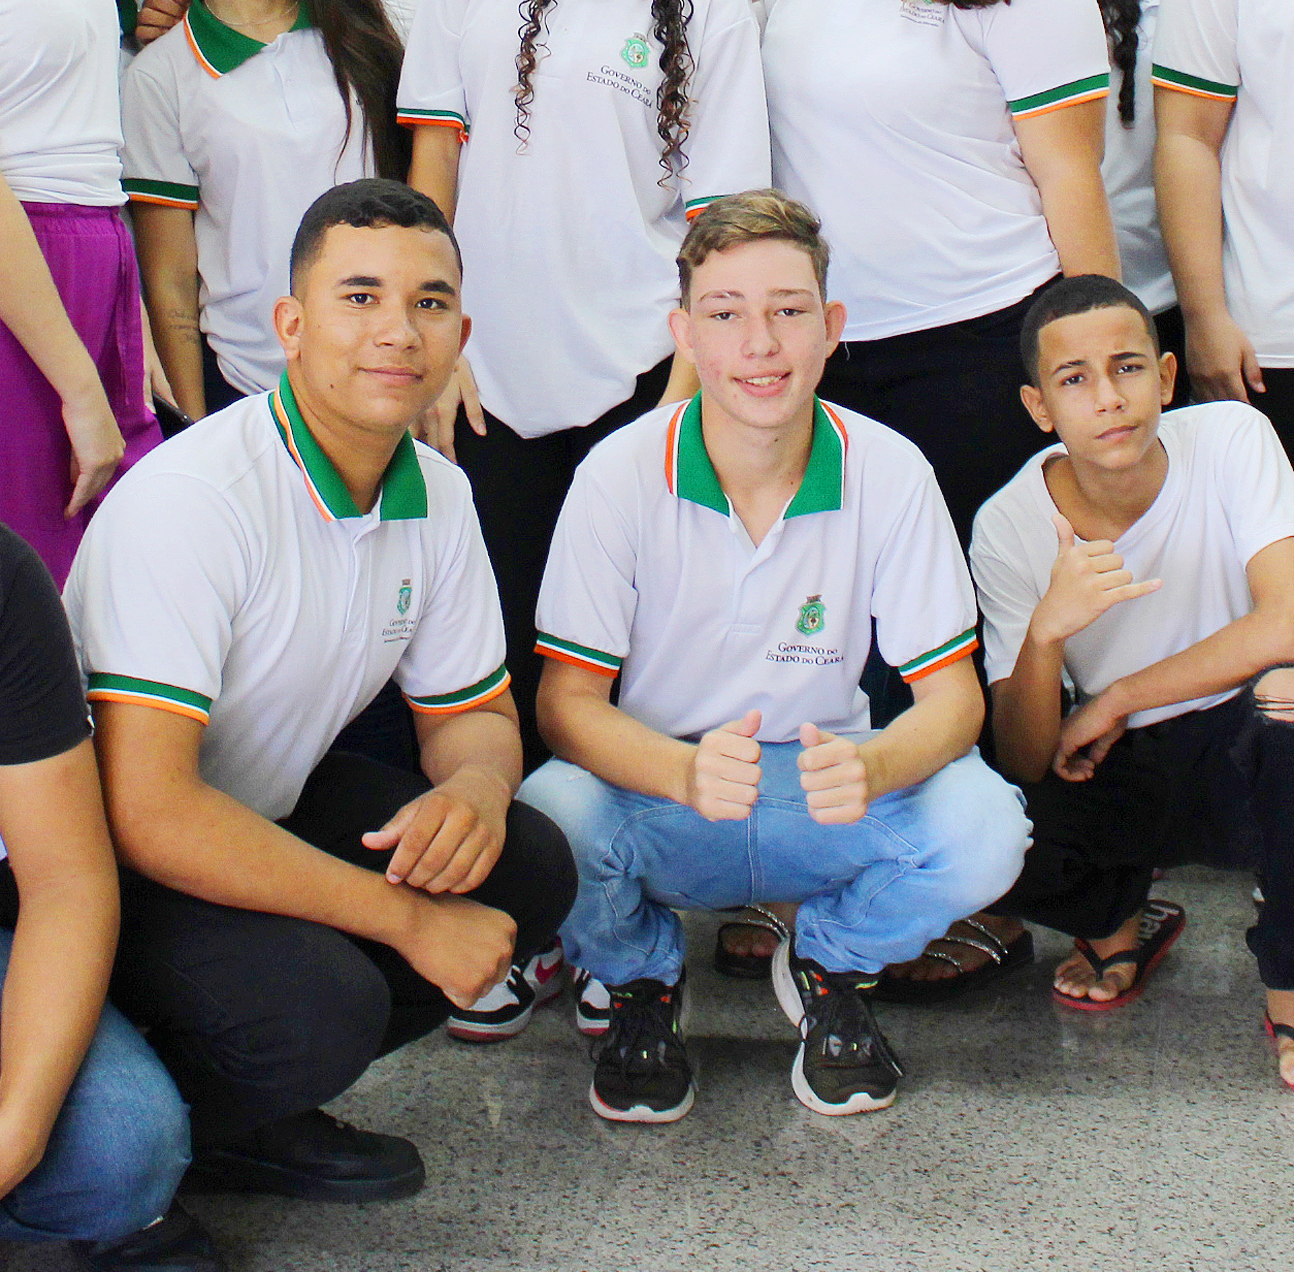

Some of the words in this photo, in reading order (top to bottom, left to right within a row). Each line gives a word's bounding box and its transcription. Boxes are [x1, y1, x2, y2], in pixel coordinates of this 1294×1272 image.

[586, 72, 620, 89] ESTADO
[620, 85, 630, 94] DO
[600, 65, 643, 89] GOVERNO
[643, 86, 651, 95] DO
[765, 650, 800, 663] ESTADO
[802, 657, 814, 665] DO
[778, 641, 825, 656] GOVERNO
